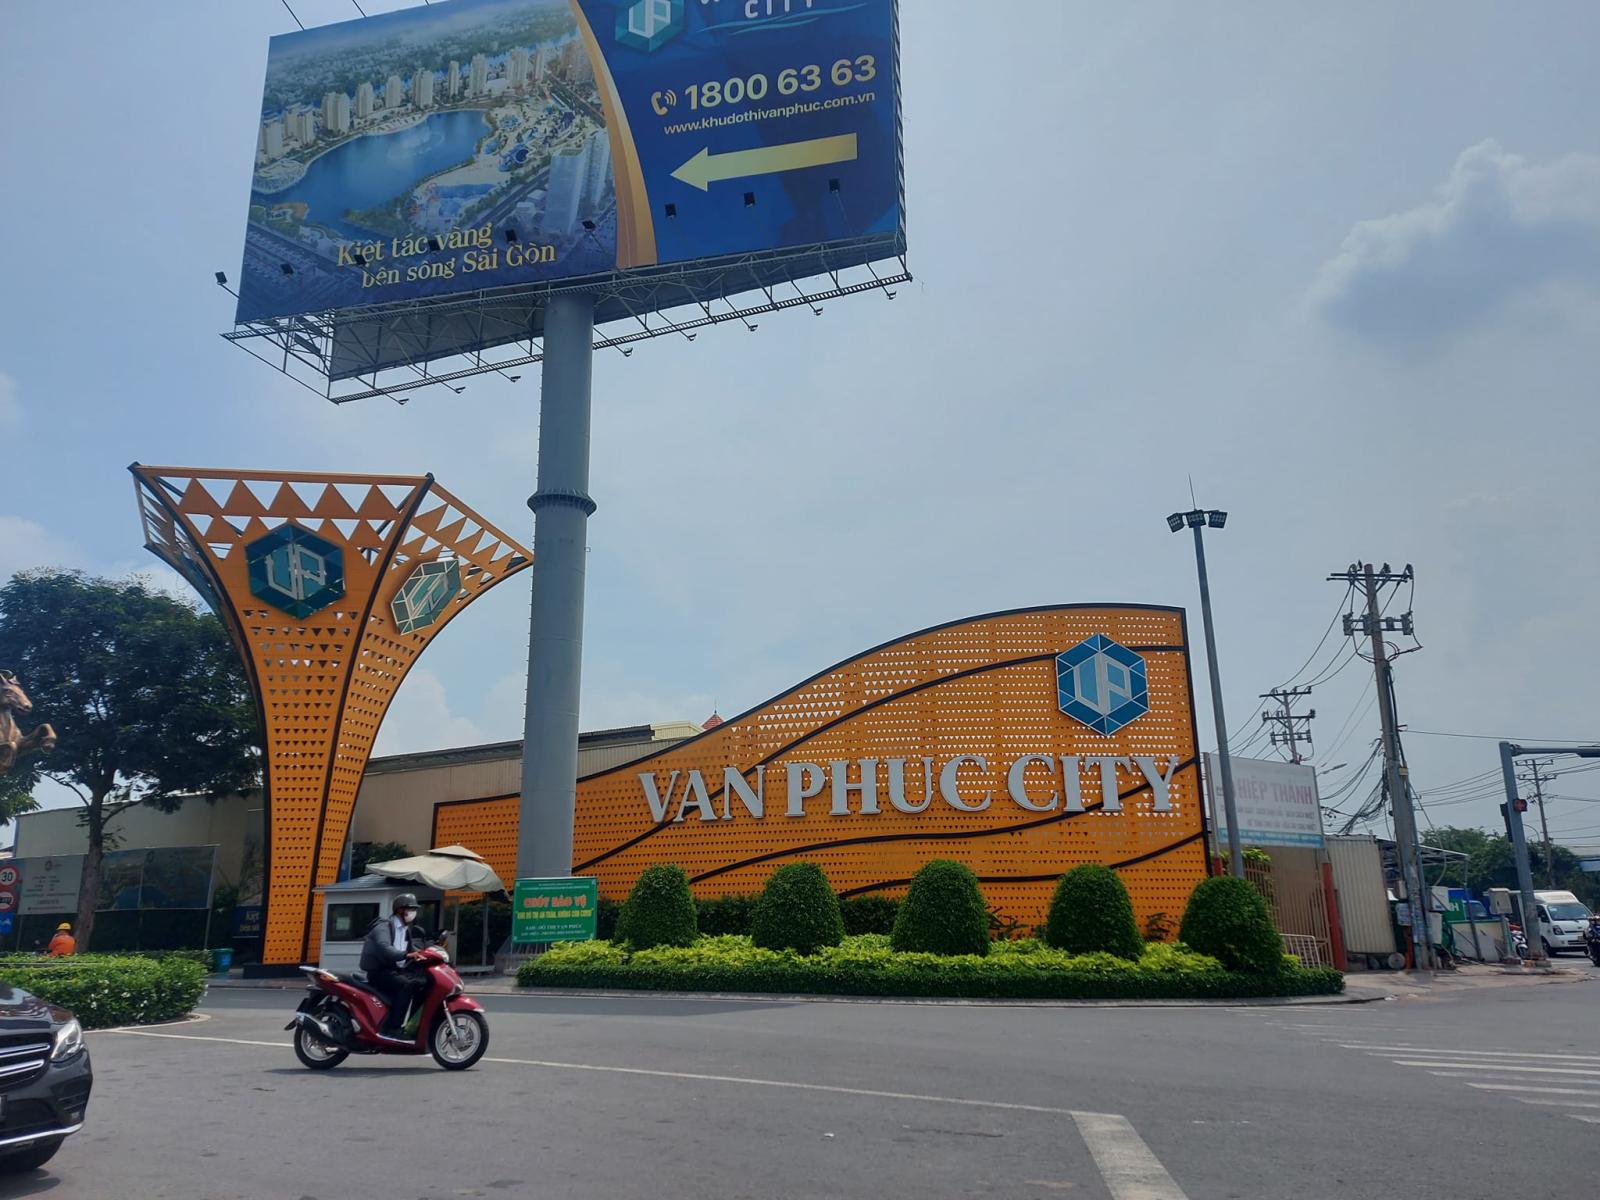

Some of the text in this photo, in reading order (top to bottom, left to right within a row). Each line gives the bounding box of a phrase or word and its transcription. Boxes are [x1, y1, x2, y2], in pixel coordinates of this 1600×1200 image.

[745, 0, 813, 18] CI
[685, 54, 877, 110] 1800 63 63
[664, 91, 876, 135] www.khudothivanphuc.com.vn
[392, 233, 428, 258] tác
[435, 222, 492, 249] vàng
[407, 257, 456, 280] sông
[462, 247, 498, 273] Sài
[506, 242, 555, 267] Gòn
[637, 753, 1180, 823] VAN PHUC CITY
[1, 871, 13, 882] 30
